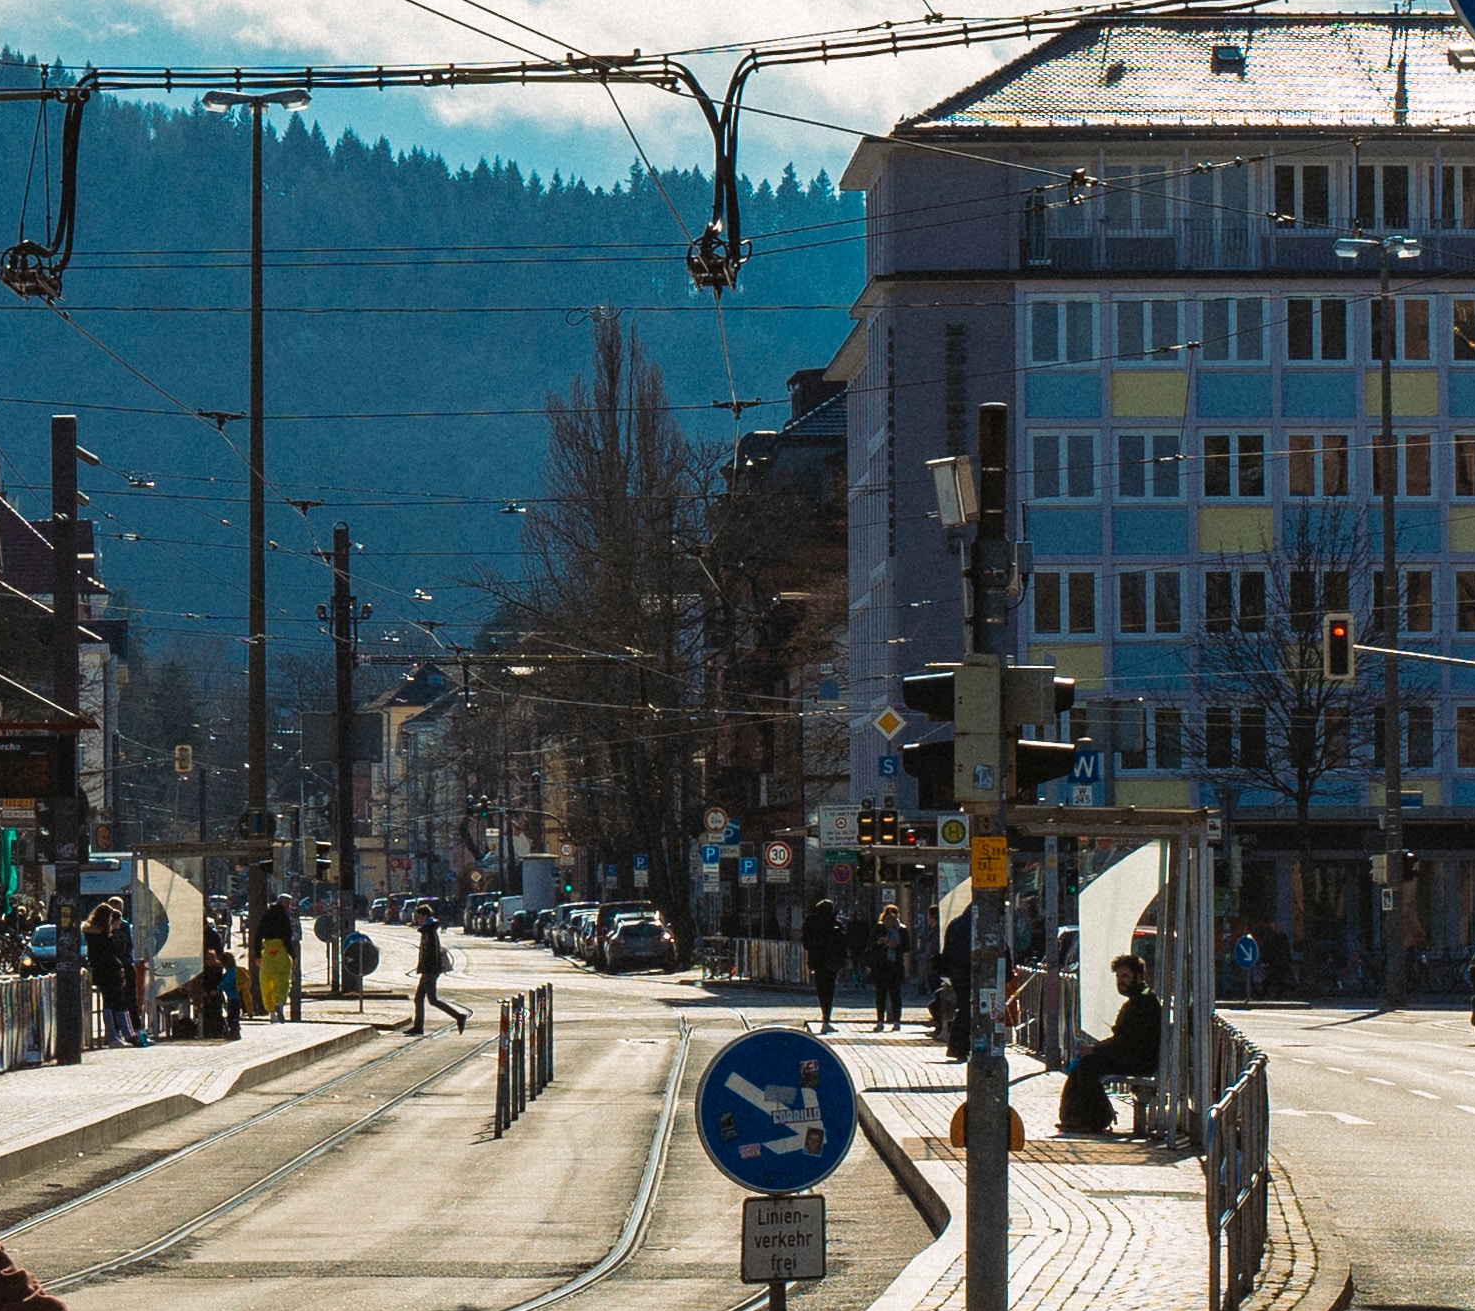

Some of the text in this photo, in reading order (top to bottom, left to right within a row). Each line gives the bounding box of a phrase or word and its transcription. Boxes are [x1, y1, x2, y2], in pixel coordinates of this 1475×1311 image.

[883, 758, 894, 774] S
[1074, 755, 1095, 778] W
[706, 848, 716, 861] P
[771, 848, 785, 861] 30
[744, 860, 753, 873] P
[757, 1208, 810, 1226] Linien-
[754, 1231, 813, 1249] verkehr
[770, 1254, 796, 1271] frei
